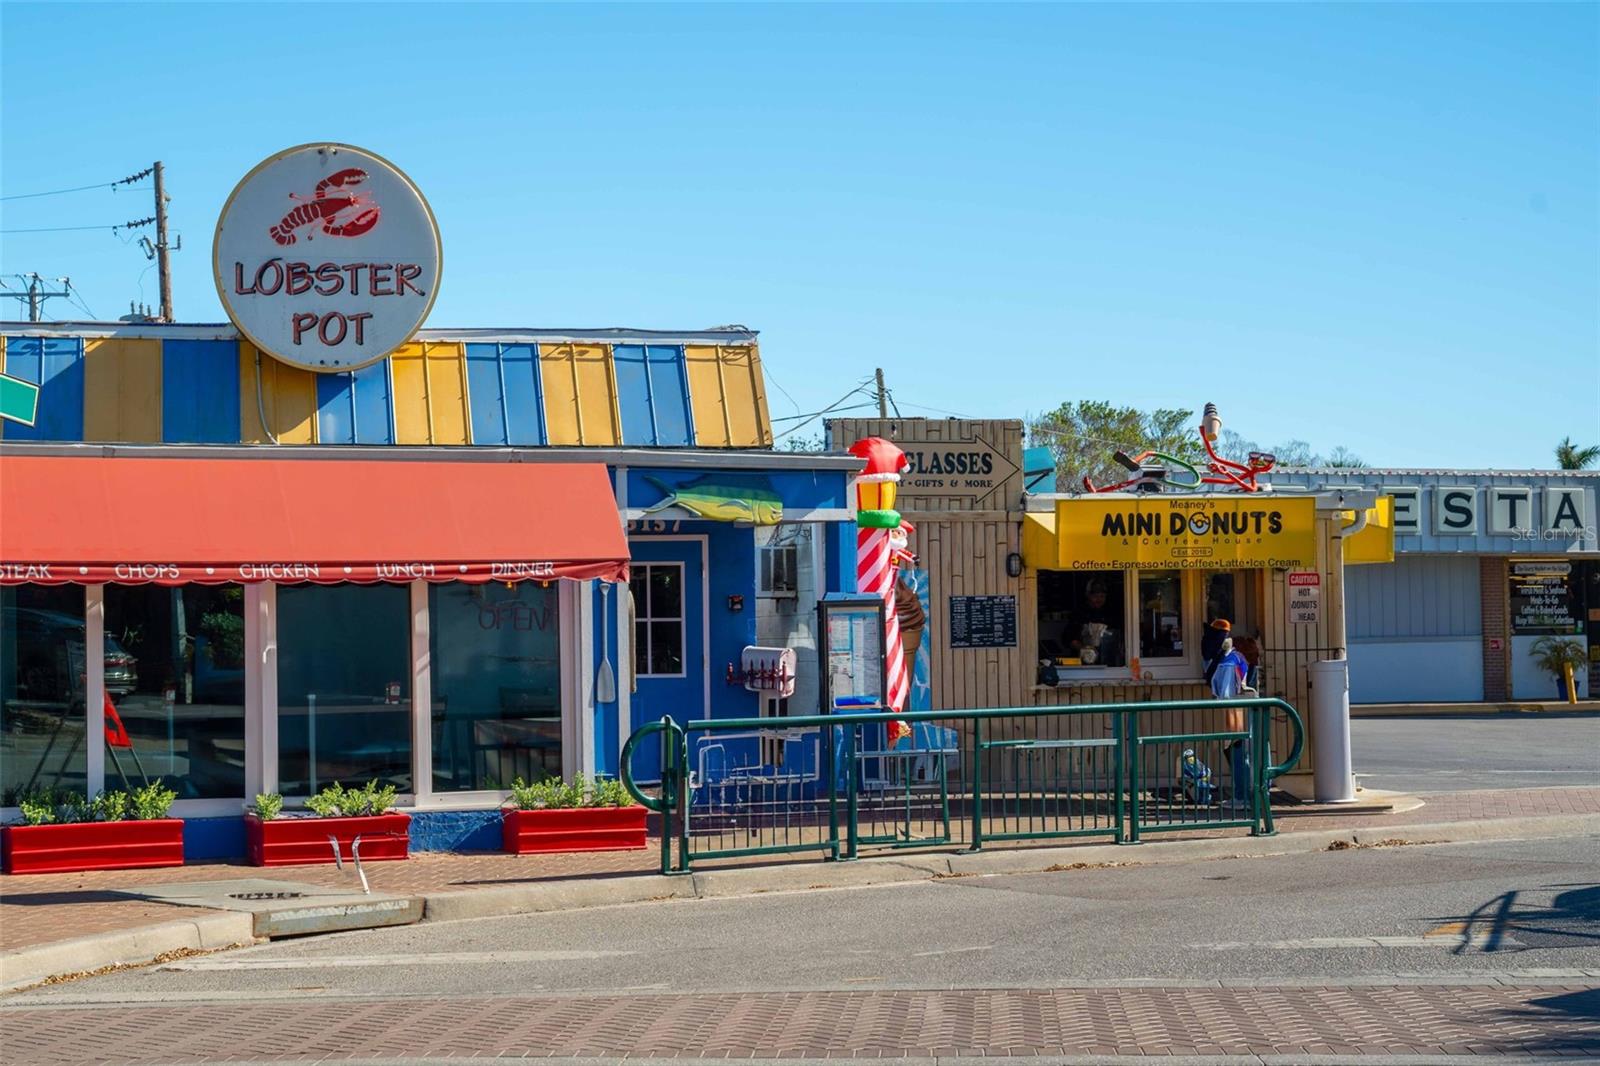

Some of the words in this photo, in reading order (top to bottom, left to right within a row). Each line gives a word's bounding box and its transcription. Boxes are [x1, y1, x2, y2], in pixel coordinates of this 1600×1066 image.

[235, 258, 426, 296] LOBSTER
[292, 311, 374, 346] POT
[914, 480, 944, 488] GIFTS
[950, 480, 958, 488] &
[965, 480, 993, 488] MORE
[1170, 500, 1215, 510] Meaney's
[1101, 512, 1162, 536] MINI
[1169, 511, 1282, 536] DONUTS
[1072, 560, 1106, 569] Coffee
[1112, 560, 1159, 570] Espresso
[1164, 560, 1179, 568] Ice
[1181, 559, 1215, 568] Coffee
[1219, 559, 1244, 568] Latte
[1250, 559, 1265, 568] Ice
[1267, 558, 1301, 567] Cream
[0, 564, 52, 579] STEAK
[114, 563, 181, 579] CHOPS
[239, 563, 320, 578] CHICKEN
[376, 563, 435, 577] LUNCH
[491, 561, 555, 576] DINNER
[1290, 575, 1318, 585] CAUTION
[1298, 588, 1311, 597] HOT
[1291, 600, 1318, 609] DONUTS
